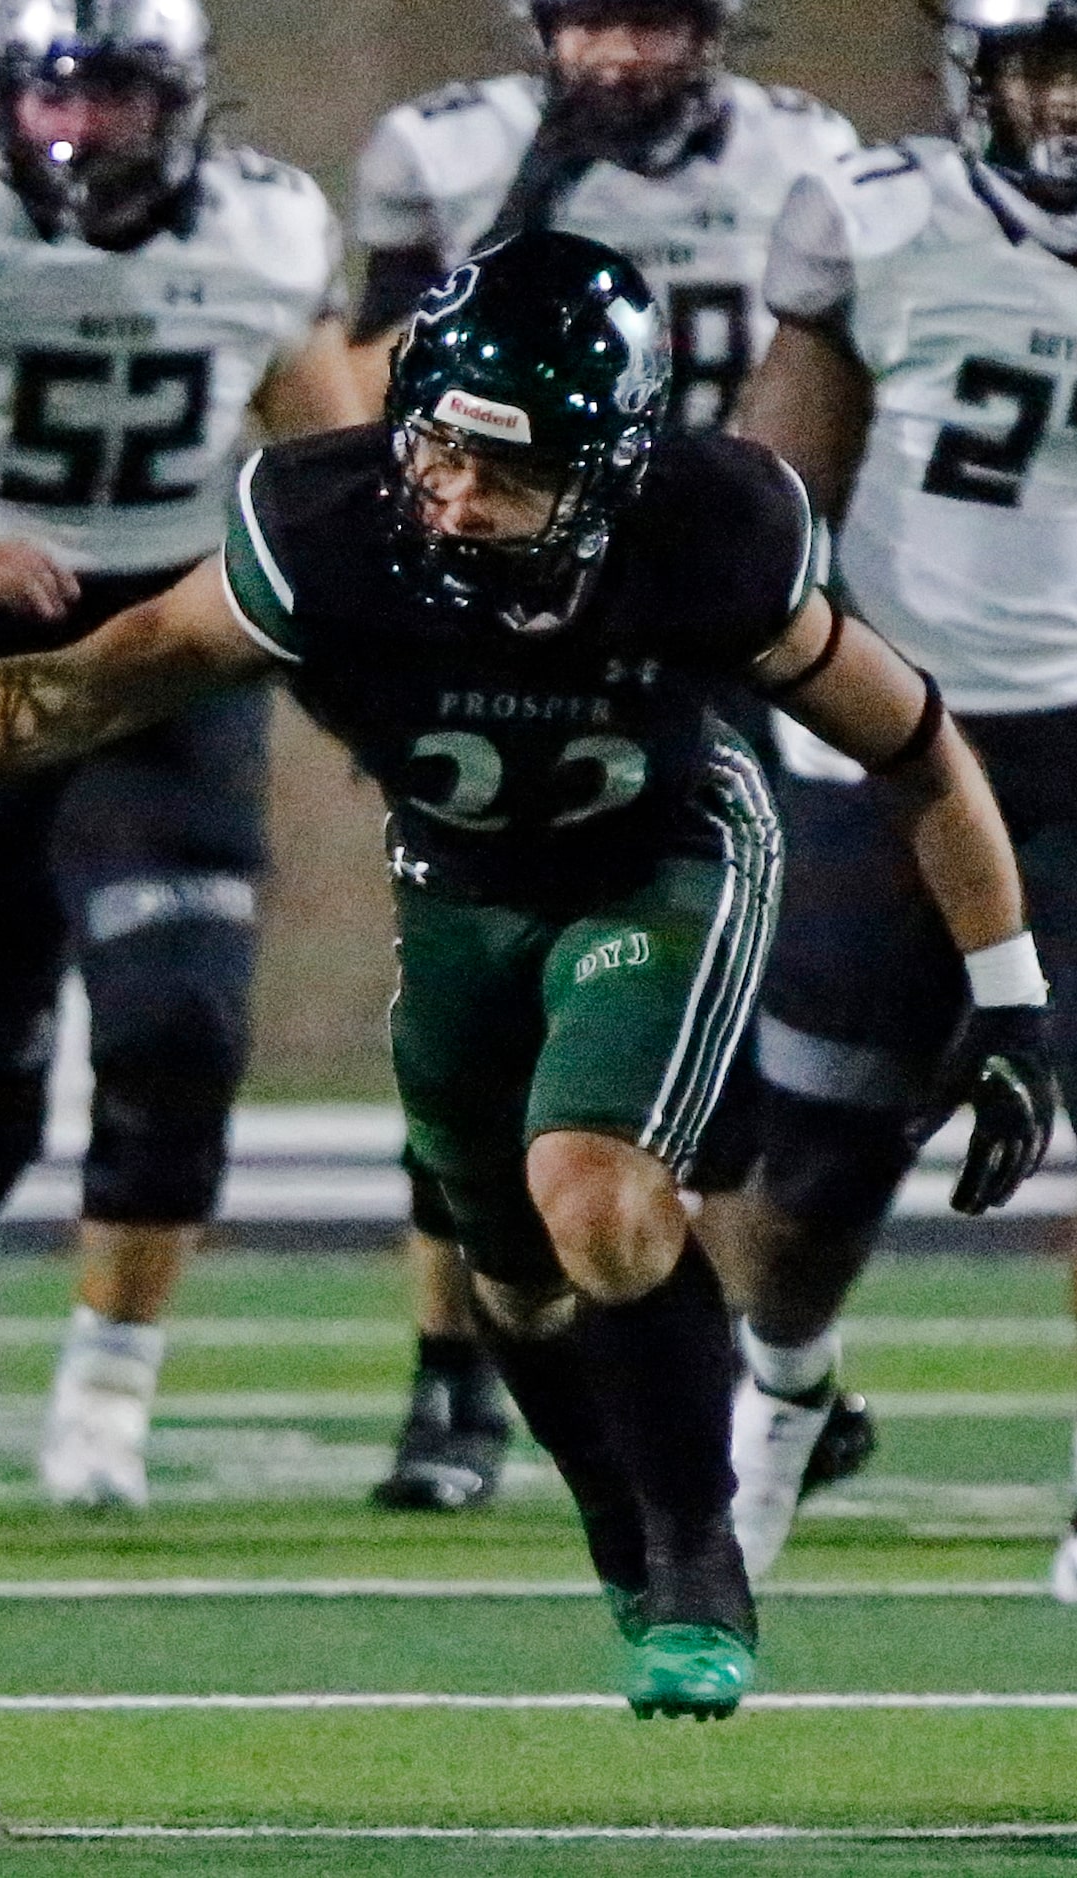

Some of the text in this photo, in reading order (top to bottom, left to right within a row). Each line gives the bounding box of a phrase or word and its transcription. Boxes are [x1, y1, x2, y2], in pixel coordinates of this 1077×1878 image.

[0, 348, 210, 506] 52
[450, 397, 518, 428] Riddell
[922, 354, 1077, 508] 2
[439, 691, 611, 723] PROSPER
[409, 731, 647, 831] 22
